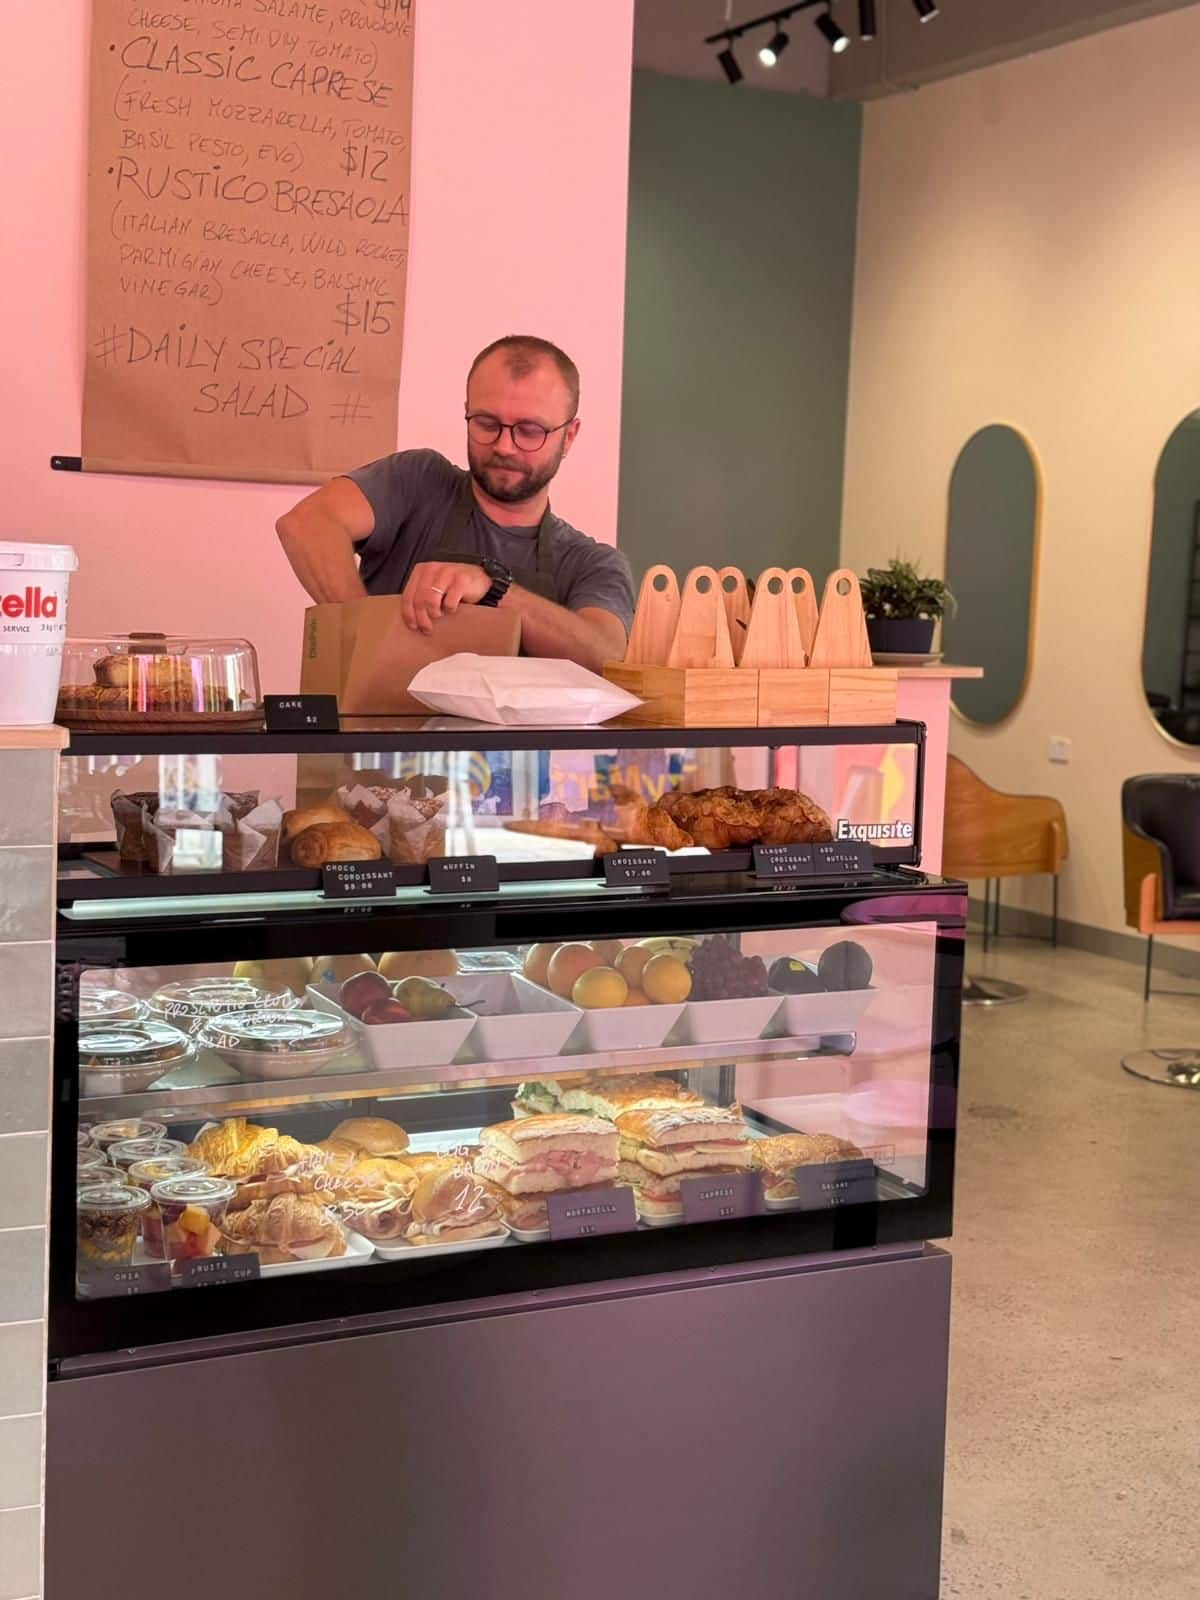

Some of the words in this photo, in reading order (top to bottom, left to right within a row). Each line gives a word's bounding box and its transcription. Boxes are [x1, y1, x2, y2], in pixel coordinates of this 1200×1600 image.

[271, 62, 393, 107] CAPRESE
[208, 98, 337, 141] MOZZARELLA,
[119, 129, 176, 151] BASIL
[340, 140, 390, 182] $12
[274, 180, 409, 226] BRESAOLA
[111, 198, 193, 241] (ITALIAN
[202, 220, 295, 255] BRESAOLA,
[301, 231, 347, 257] WILD
[119, 276, 224, 306] VINEGAR)
[230, 260, 307, 289] CHEESE,
[332, 292, 395, 336] $15
[238, 336, 361, 374] SPECIAL
[193, 381, 310, 419] SALAD
[0, 586, 58, 619] ella
[837, 819, 914, 842] Exquisite
[326, 864, 356, 872] CHOCO
[455, 1183, 486, 1213] 12
